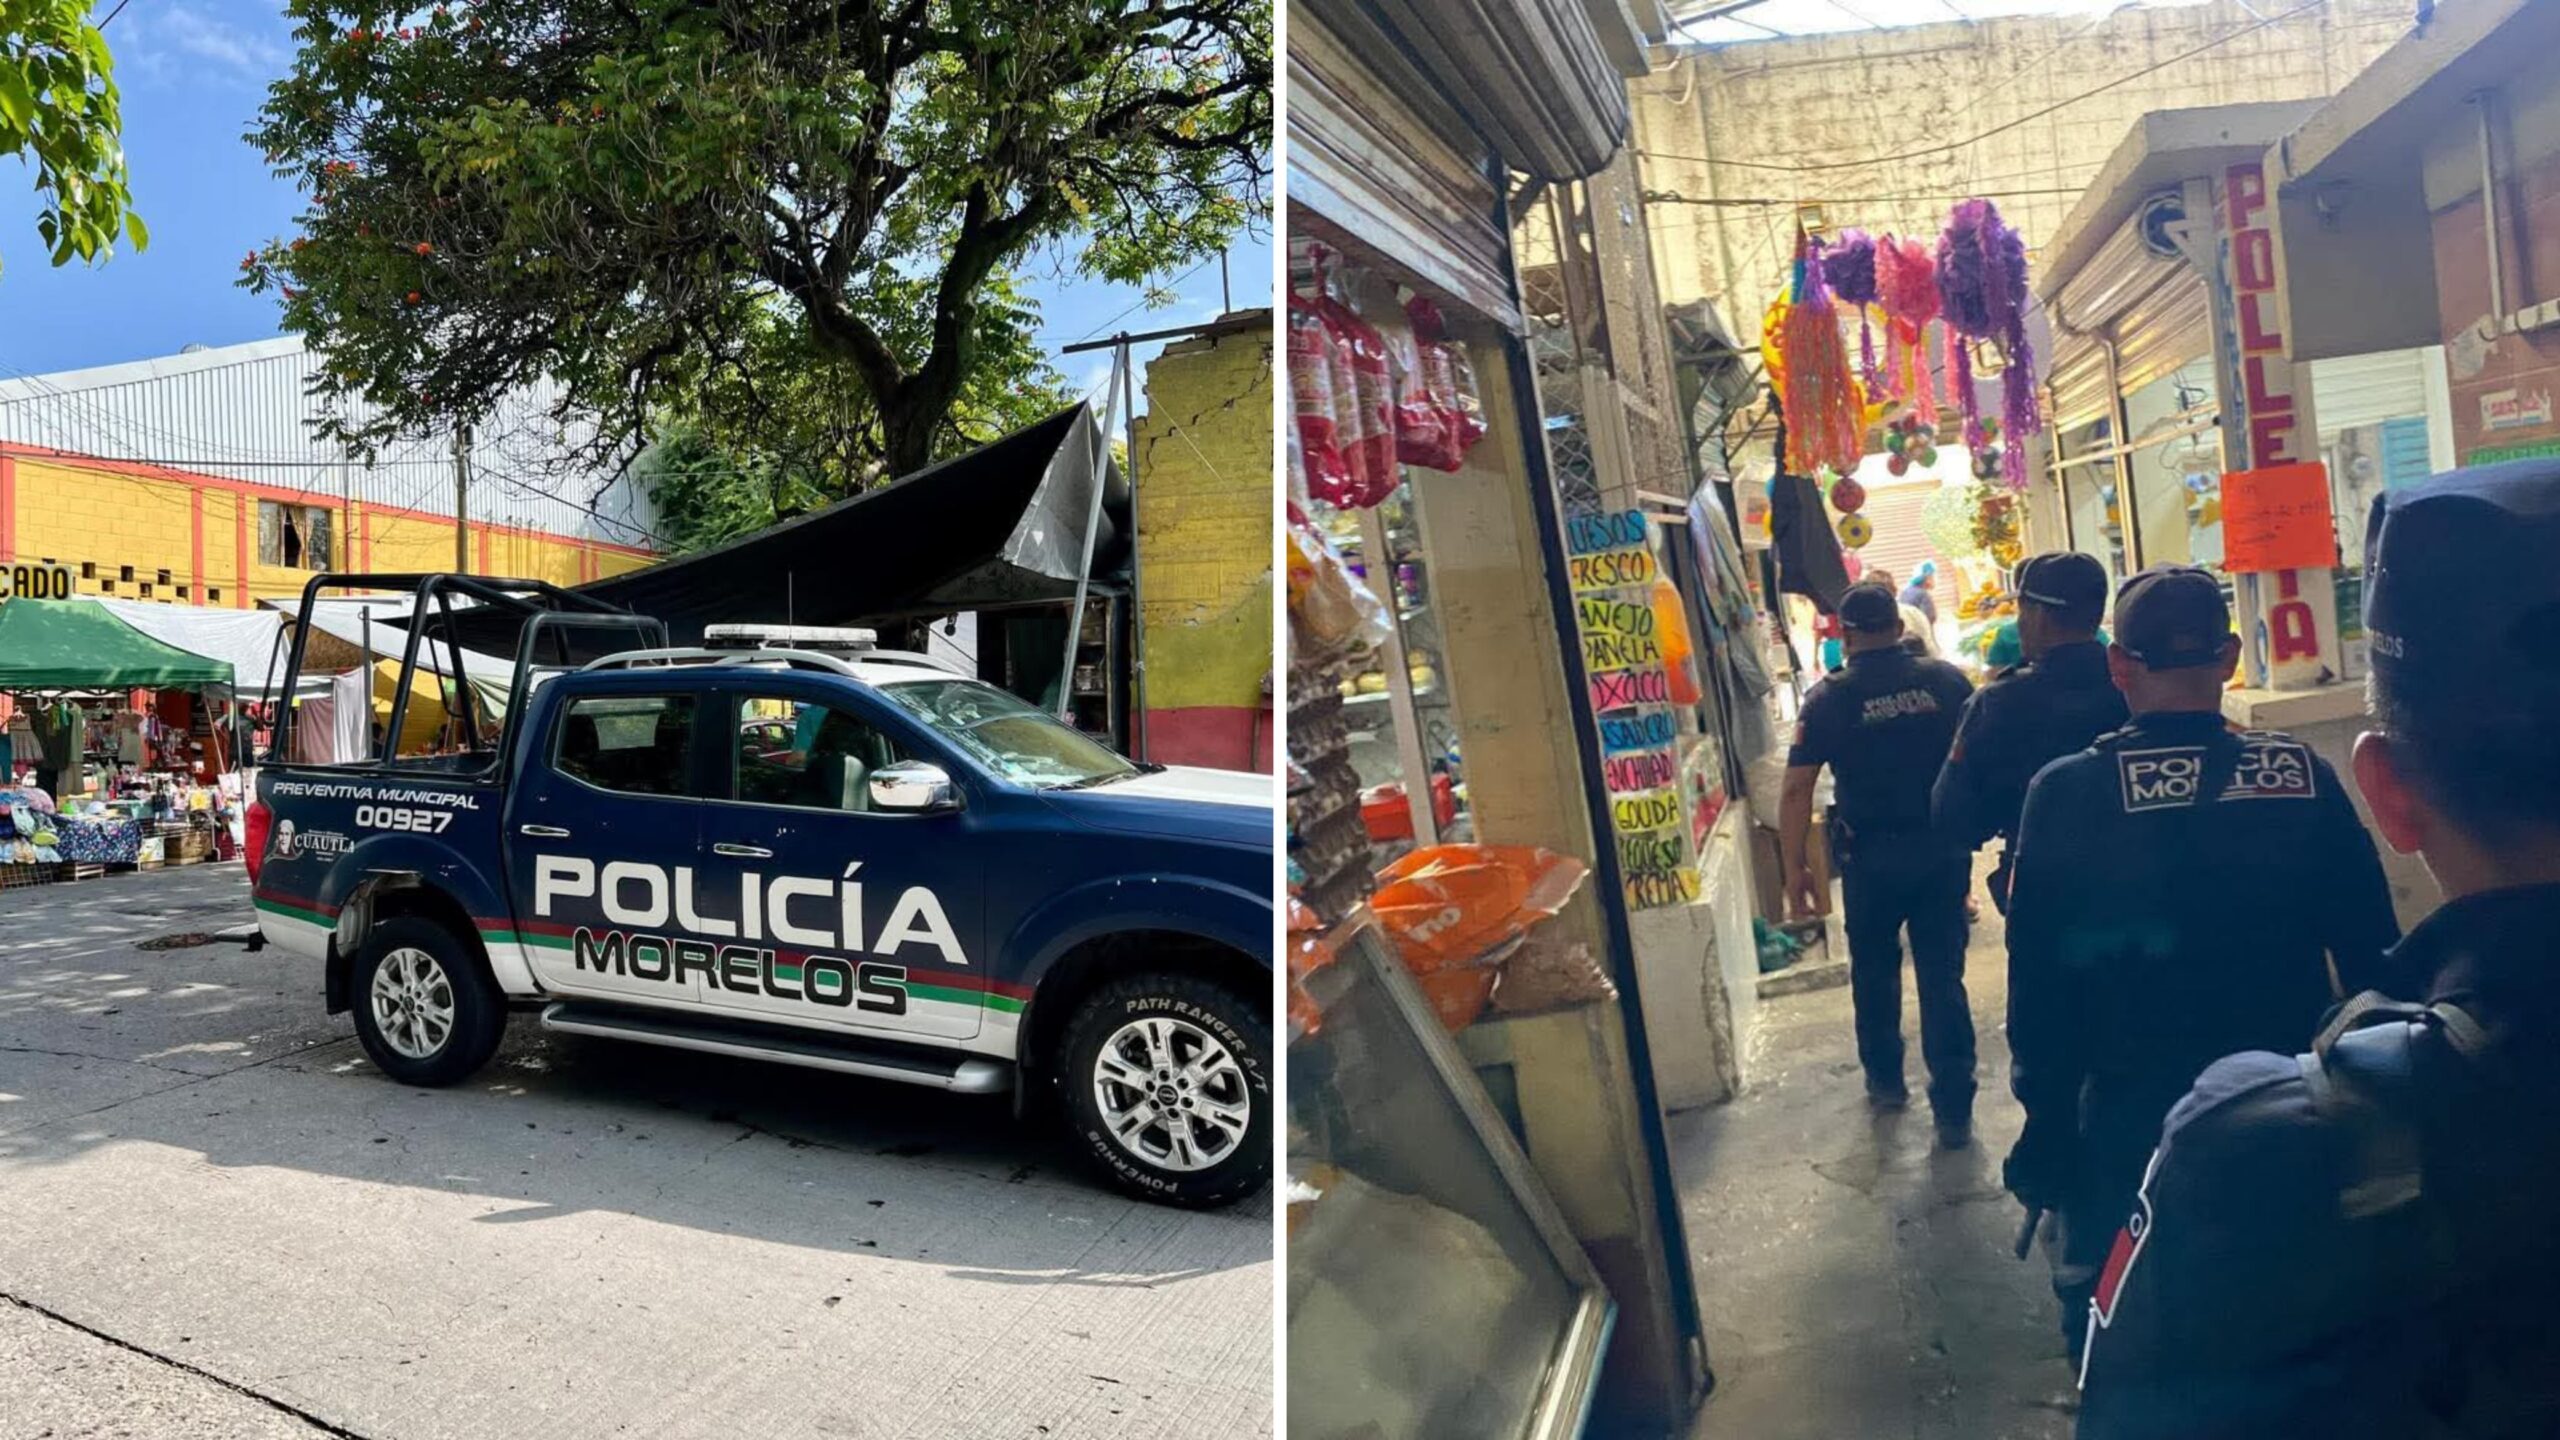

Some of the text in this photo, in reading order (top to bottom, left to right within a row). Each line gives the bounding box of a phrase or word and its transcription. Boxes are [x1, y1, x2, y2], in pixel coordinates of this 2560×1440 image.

[2226, 163, 2319, 663] POLLEA
[272, 782, 480, 810] PREVENTIVA MUNICIPAL
[355, 805, 453, 834] 00927
[294, 834, 355, 853] CUAUTLA
[535, 854, 969, 965] POLICÍA
[573, 926, 907, 1016] MORELOS
[1126, 998, 1171, 1013] PATH
[1174, 1001, 1247, 1052] RANGER
